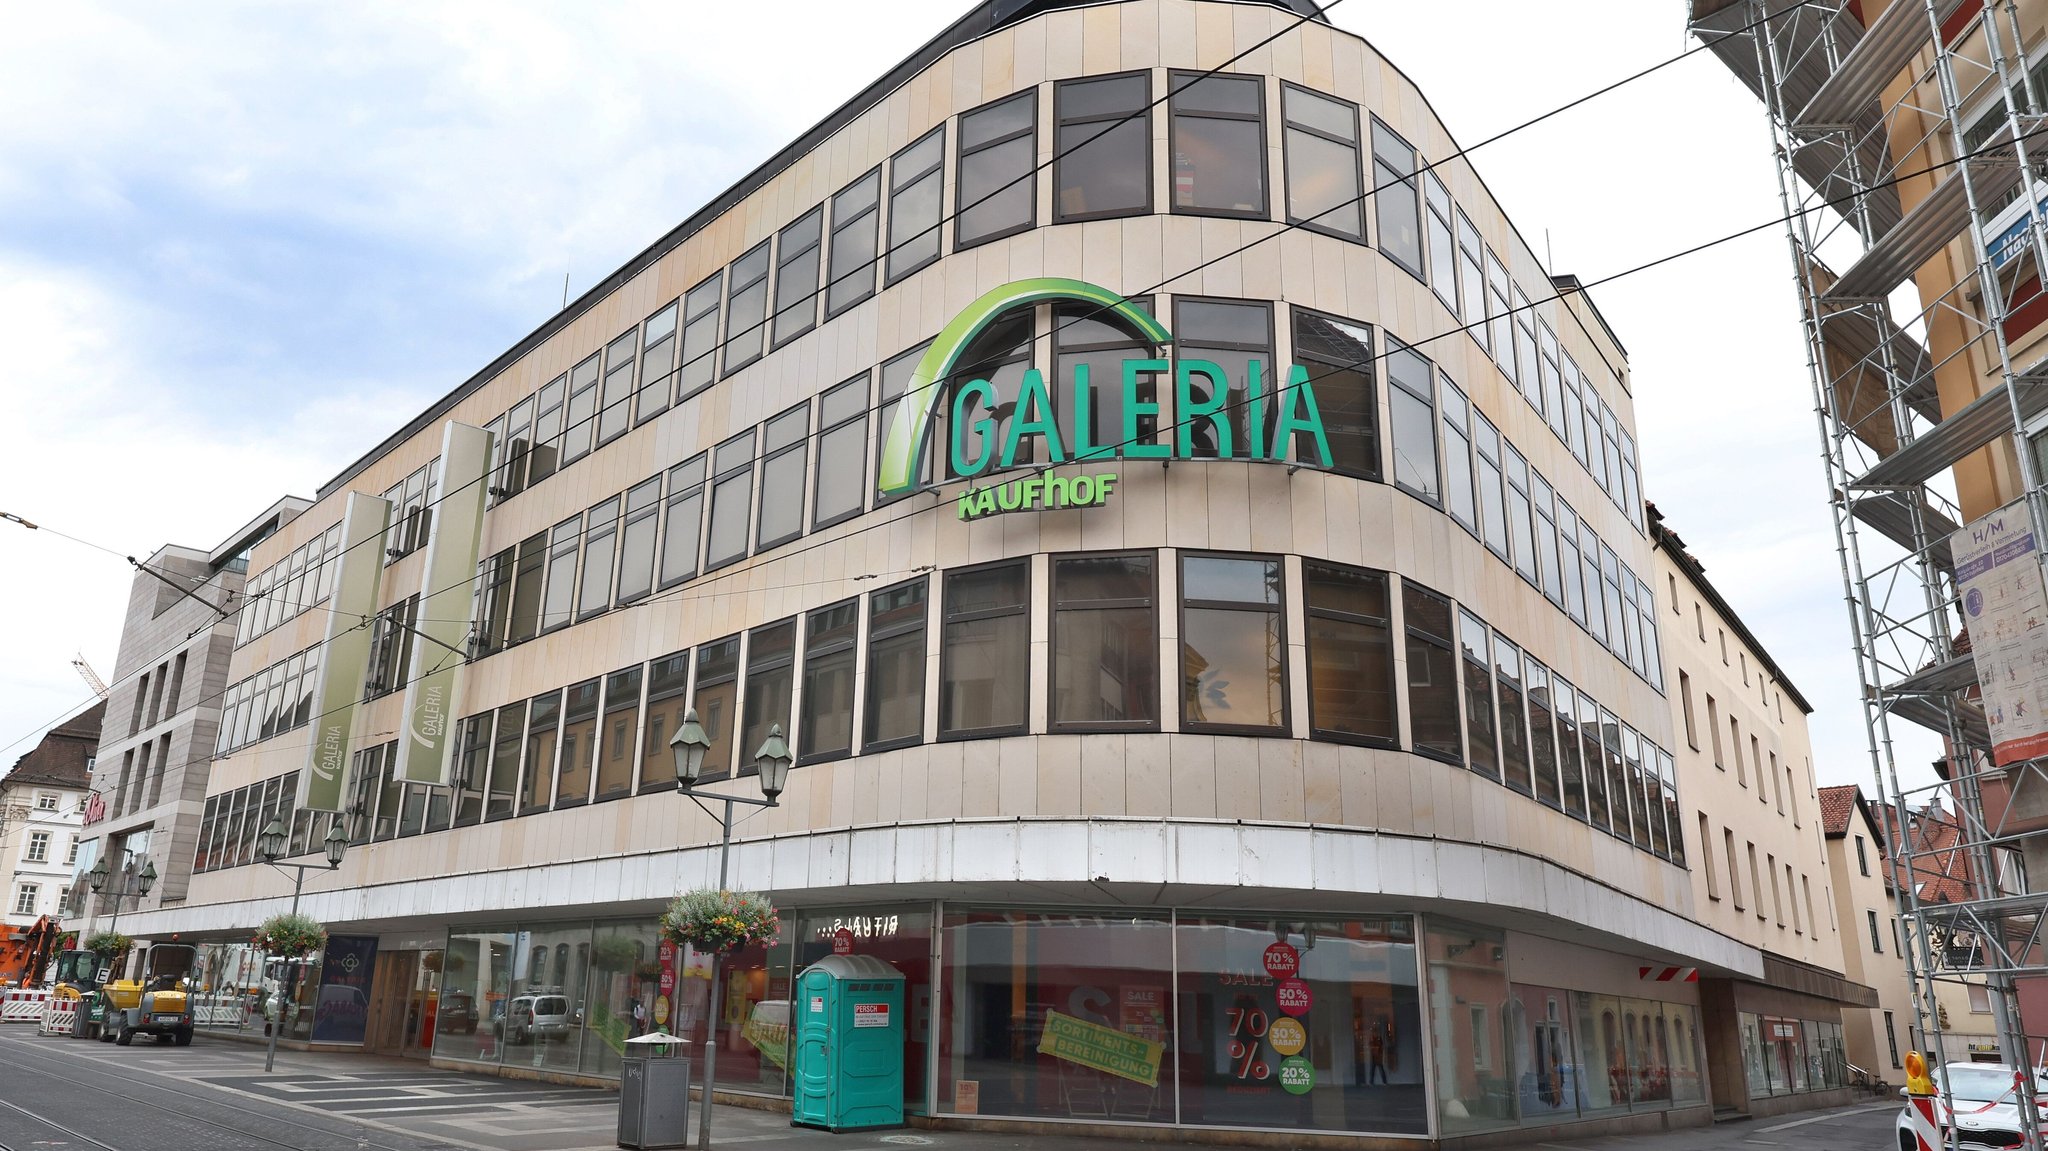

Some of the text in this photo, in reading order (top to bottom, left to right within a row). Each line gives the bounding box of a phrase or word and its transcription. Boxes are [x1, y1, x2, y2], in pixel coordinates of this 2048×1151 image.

[951, 358, 1334, 478] GALERIA
[1972, 518, 2004, 545] H/M
[421, 686, 443, 736] GALERIA
[321, 725, 343, 770] GALERIA
[99, 969, 110, 982] E
[855, 1005, 878, 1013] PERSCH
[1127, 991, 1155, 1000] SALE
[1057, 1040, 1151, 1076] BEREINIGUNG
